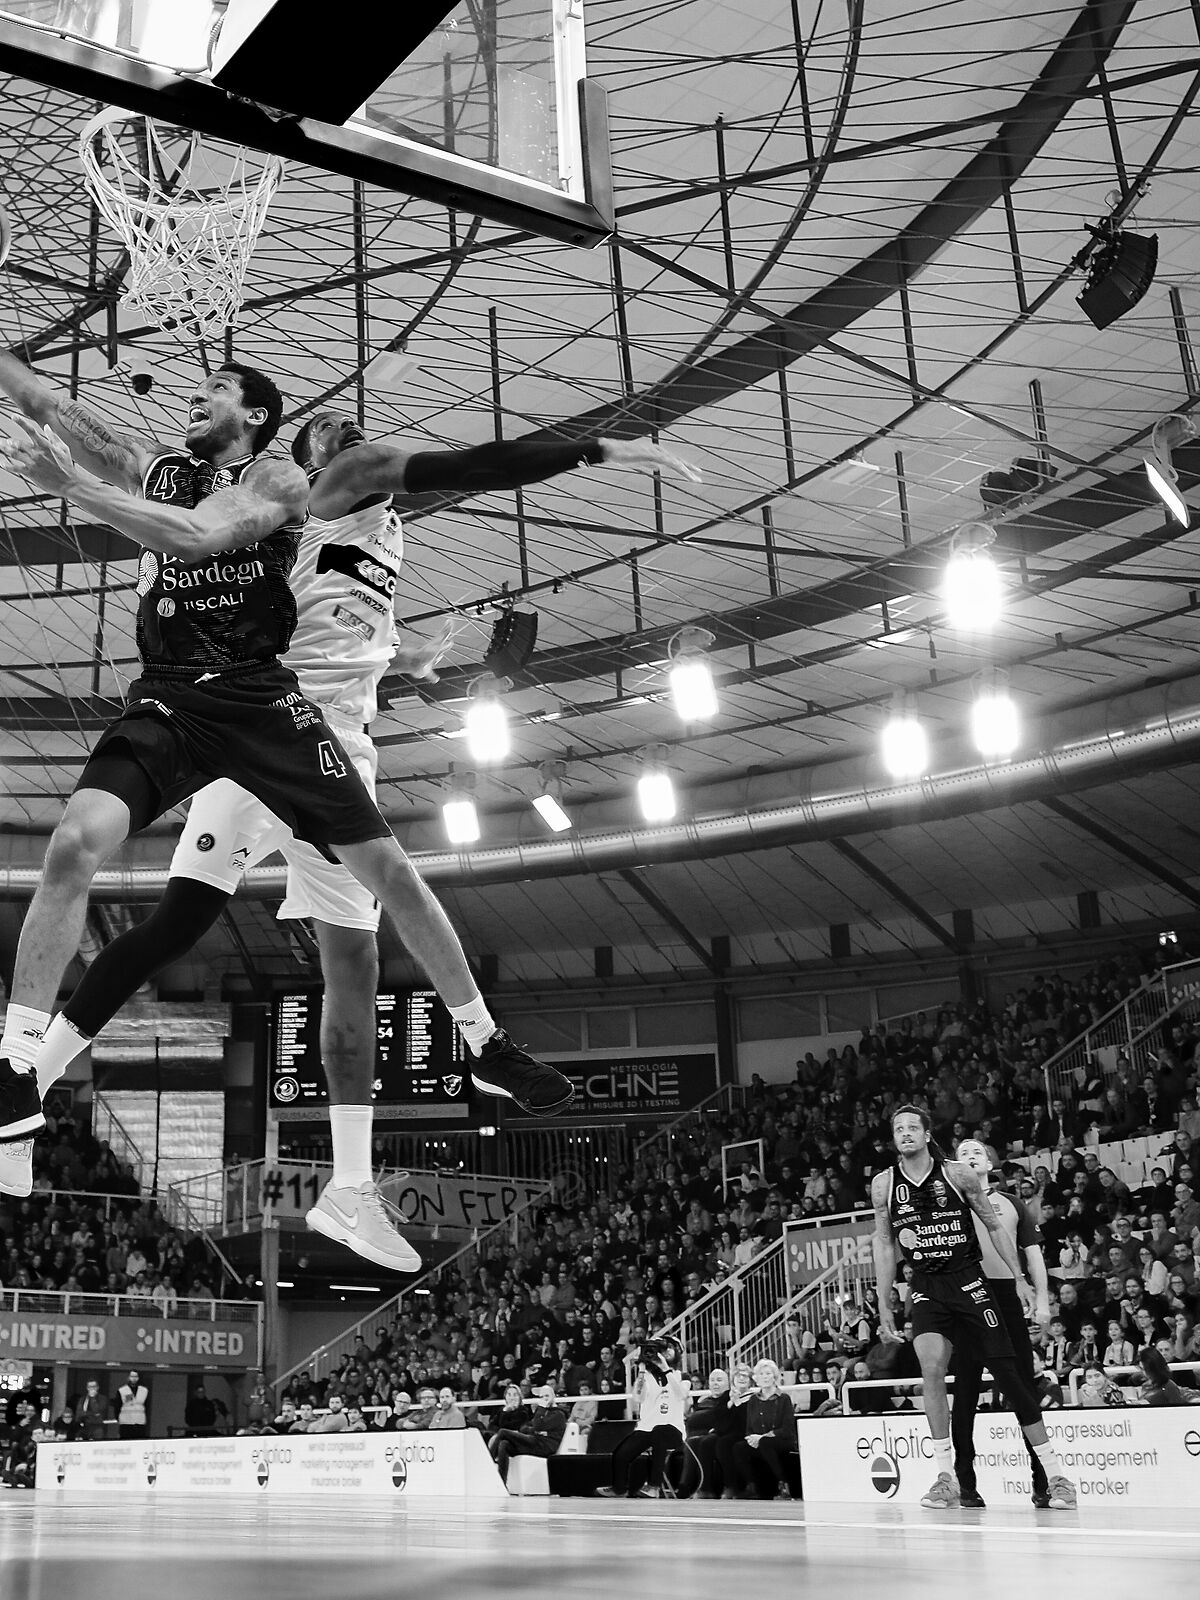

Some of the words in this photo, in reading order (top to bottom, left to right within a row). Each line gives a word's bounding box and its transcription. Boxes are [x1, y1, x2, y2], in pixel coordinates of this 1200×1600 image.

[153, 466, 180, 500] 4
[161, 560, 265, 591] Sardegn
[317, 740, 347, 778] 4
[377, 1026, 394, 1039] 54
[610, 1062, 678, 1073] METROLOGIA
[567, 1071, 680, 1099] ECHNE
[593, 1100, 625, 1109] MISURE
[645, 1098, 680, 1107] TESTING
[399, 1183, 446, 1222] ON
[895, 1183, 910, 1204] 0
[914, 1222, 949, 1236] Banco
[950, 1219, 962, 1232] di
[915, 1233, 968, 1248] Sardegna
[806, 1234, 873, 1271] INTRE
[10, 1322, 106, 1350] INTRED
[154, 1328, 244, 1356] INTRED
[856, 1420, 935, 1461] ecliptic
[989, 1425, 1023, 1440] servi
[1047, 1419, 1132, 1442] ongressuali
[973, 1450, 1033, 1467] marketin
[1079, 1477, 1131, 1495] broker
